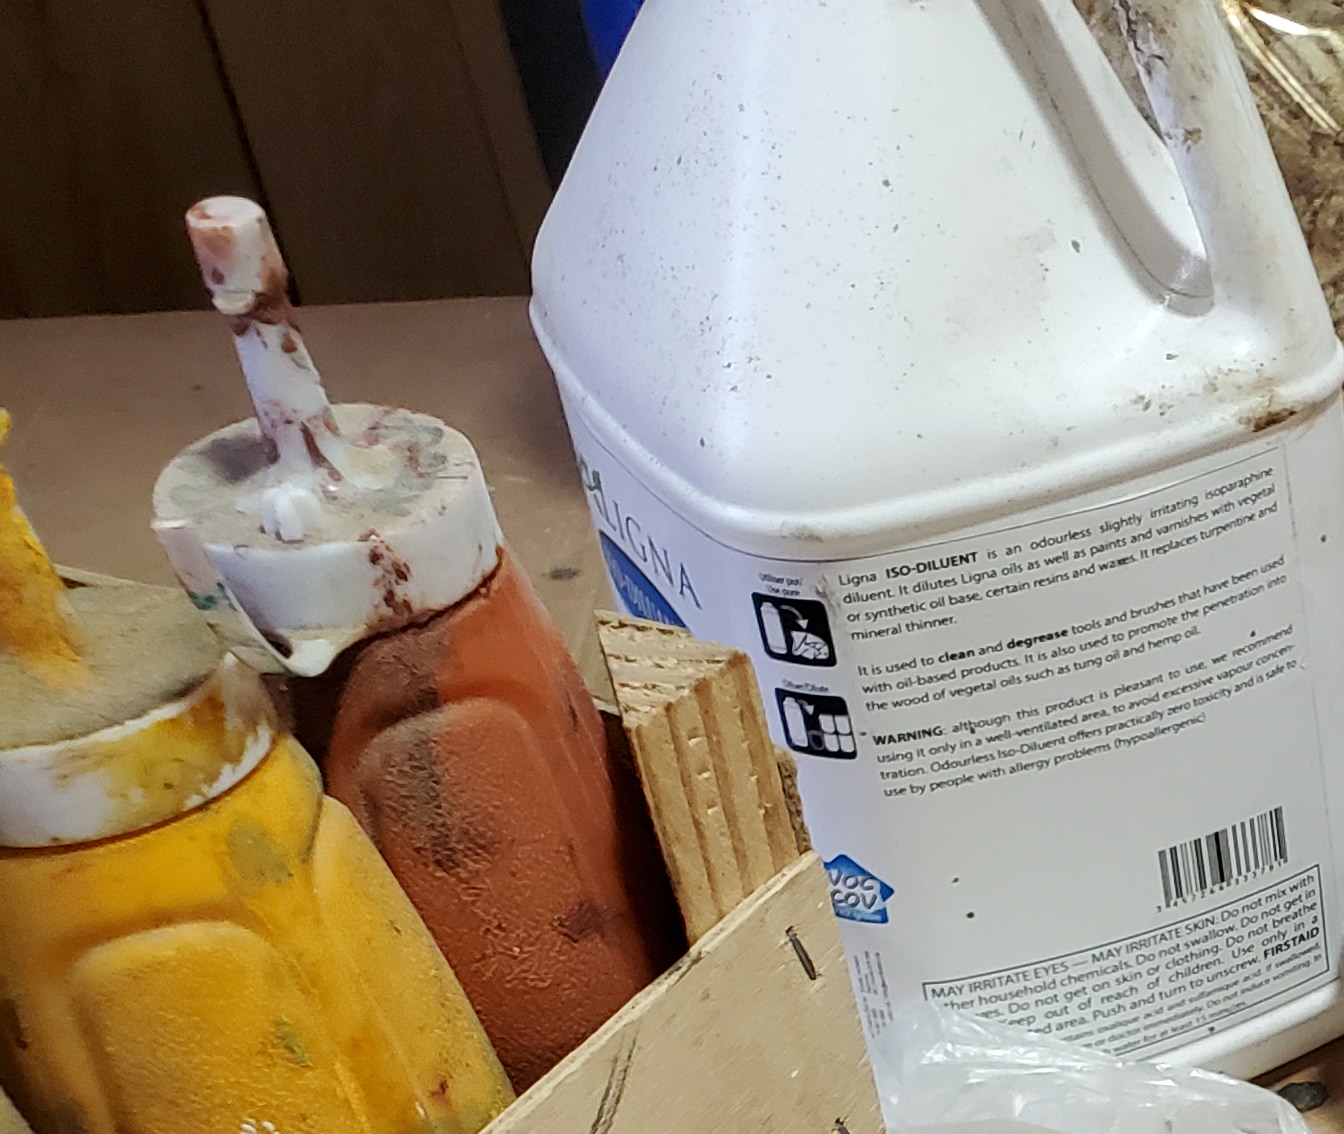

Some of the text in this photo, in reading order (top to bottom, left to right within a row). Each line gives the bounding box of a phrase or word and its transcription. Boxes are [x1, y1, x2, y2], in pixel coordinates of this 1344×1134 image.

[838, 467, 1275, 587] Ligna ISO-DILUENT is an odourless slightly irritating isoparaphine
[850, 616, 958, 640] mineral thinner.
[857, 554, 1286, 677] It is used to clean and degrease tools and brushes that have been used
[872, 623, 1295, 746] WARNING: although this product is pleasant to use, we recommend
[883, 712, 1208, 797] use by people with allergy problems (hypoallergenic)
[930, 873, 1316, 999] MAY IRRITATE EYES MAY IRRITATE SKIN: Do not mix with
